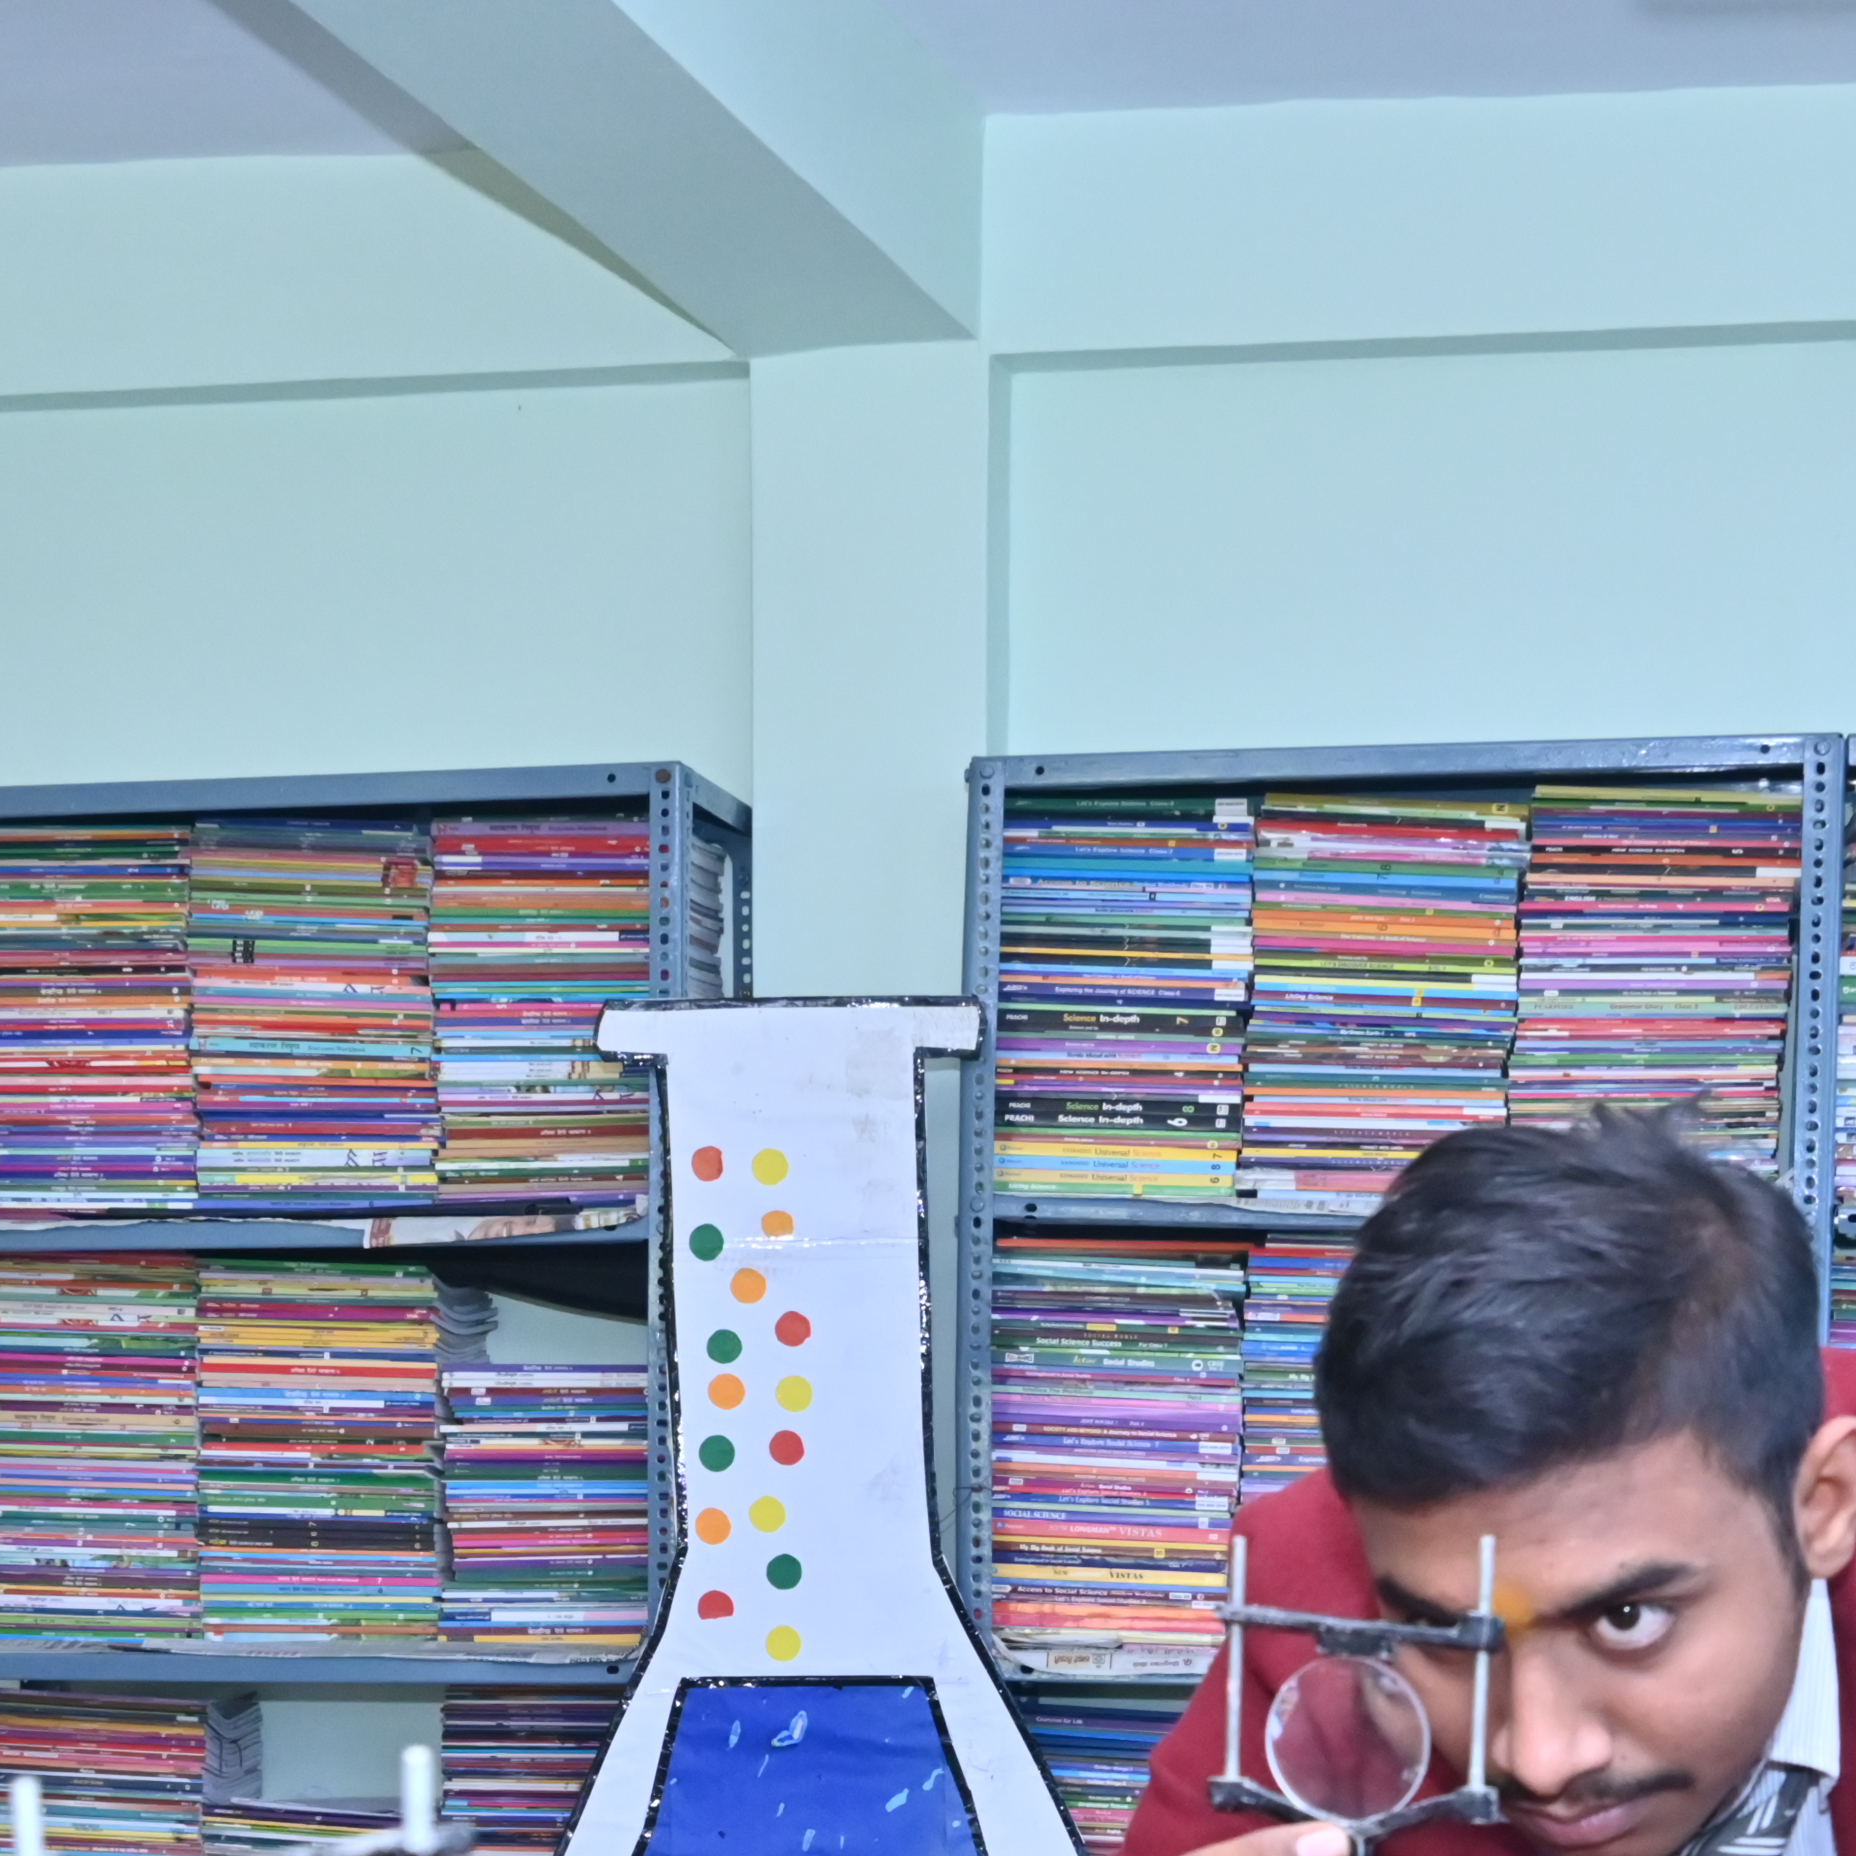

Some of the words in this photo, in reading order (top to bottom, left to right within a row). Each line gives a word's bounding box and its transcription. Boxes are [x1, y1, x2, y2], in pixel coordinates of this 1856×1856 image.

[1063, 1014, 1096, 1022] Science
[1099, 1014, 1140, 1024] In-depth
[1066, 1102, 1099, 1111] Science
[1102, 1103, 1142, 1112] In-depth
[1058, 1115, 1095, 1124] Science
[1099, 1116, 1143, 1125] In-depth
[1095, 1148, 1130, 1156] Universal
[1036, 1337, 1060, 1345] Social
[1061, 1338, 1090, 1346] Science
[1092, 1339, 1122, 1347] Success
[1103, 1358, 1124, 1366] Social
[1004, 1510, 1031, 1518] SOCIAL
[1033, 1511, 1066, 1520] SCIENCE
[1118, 1527, 1162, 1538] VISTAS
[1109, 1571, 1143, 1579] VISTAS
[1079, 1588, 1108, 1596] Science
